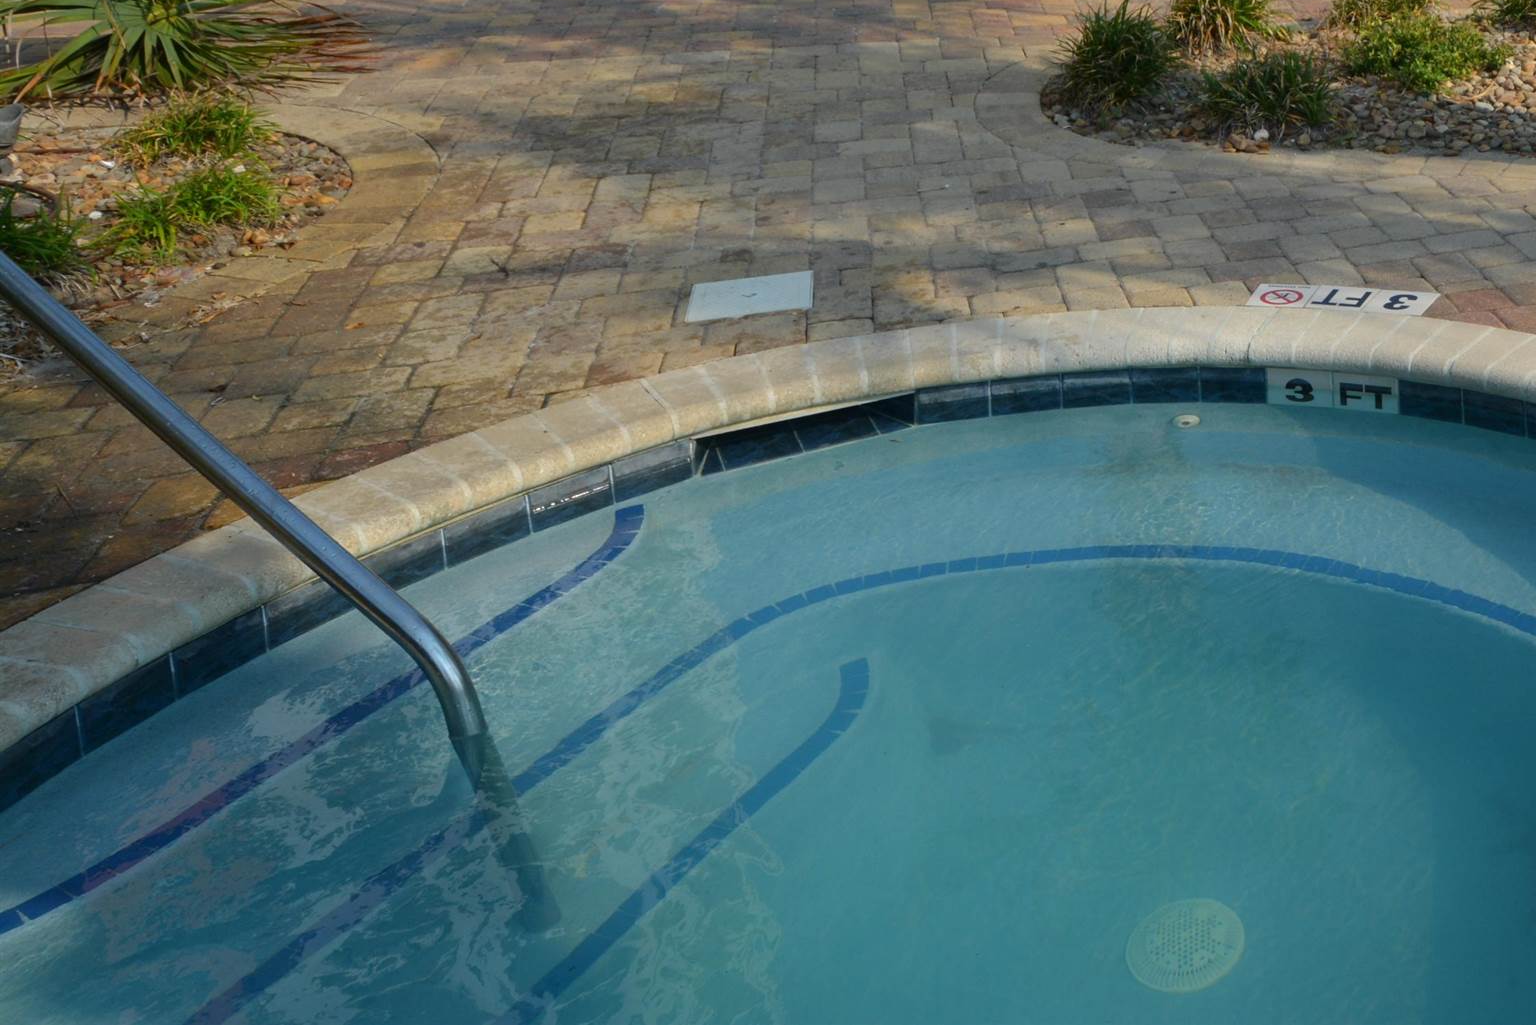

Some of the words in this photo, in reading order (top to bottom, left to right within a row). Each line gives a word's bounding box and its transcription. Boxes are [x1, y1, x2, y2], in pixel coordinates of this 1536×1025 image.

[1311, 289, 1372, 307] FT
[1383, 294, 1418, 310] 3
[1285, 378, 1314, 402] 3
[1340, 382, 1392, 410] FT
